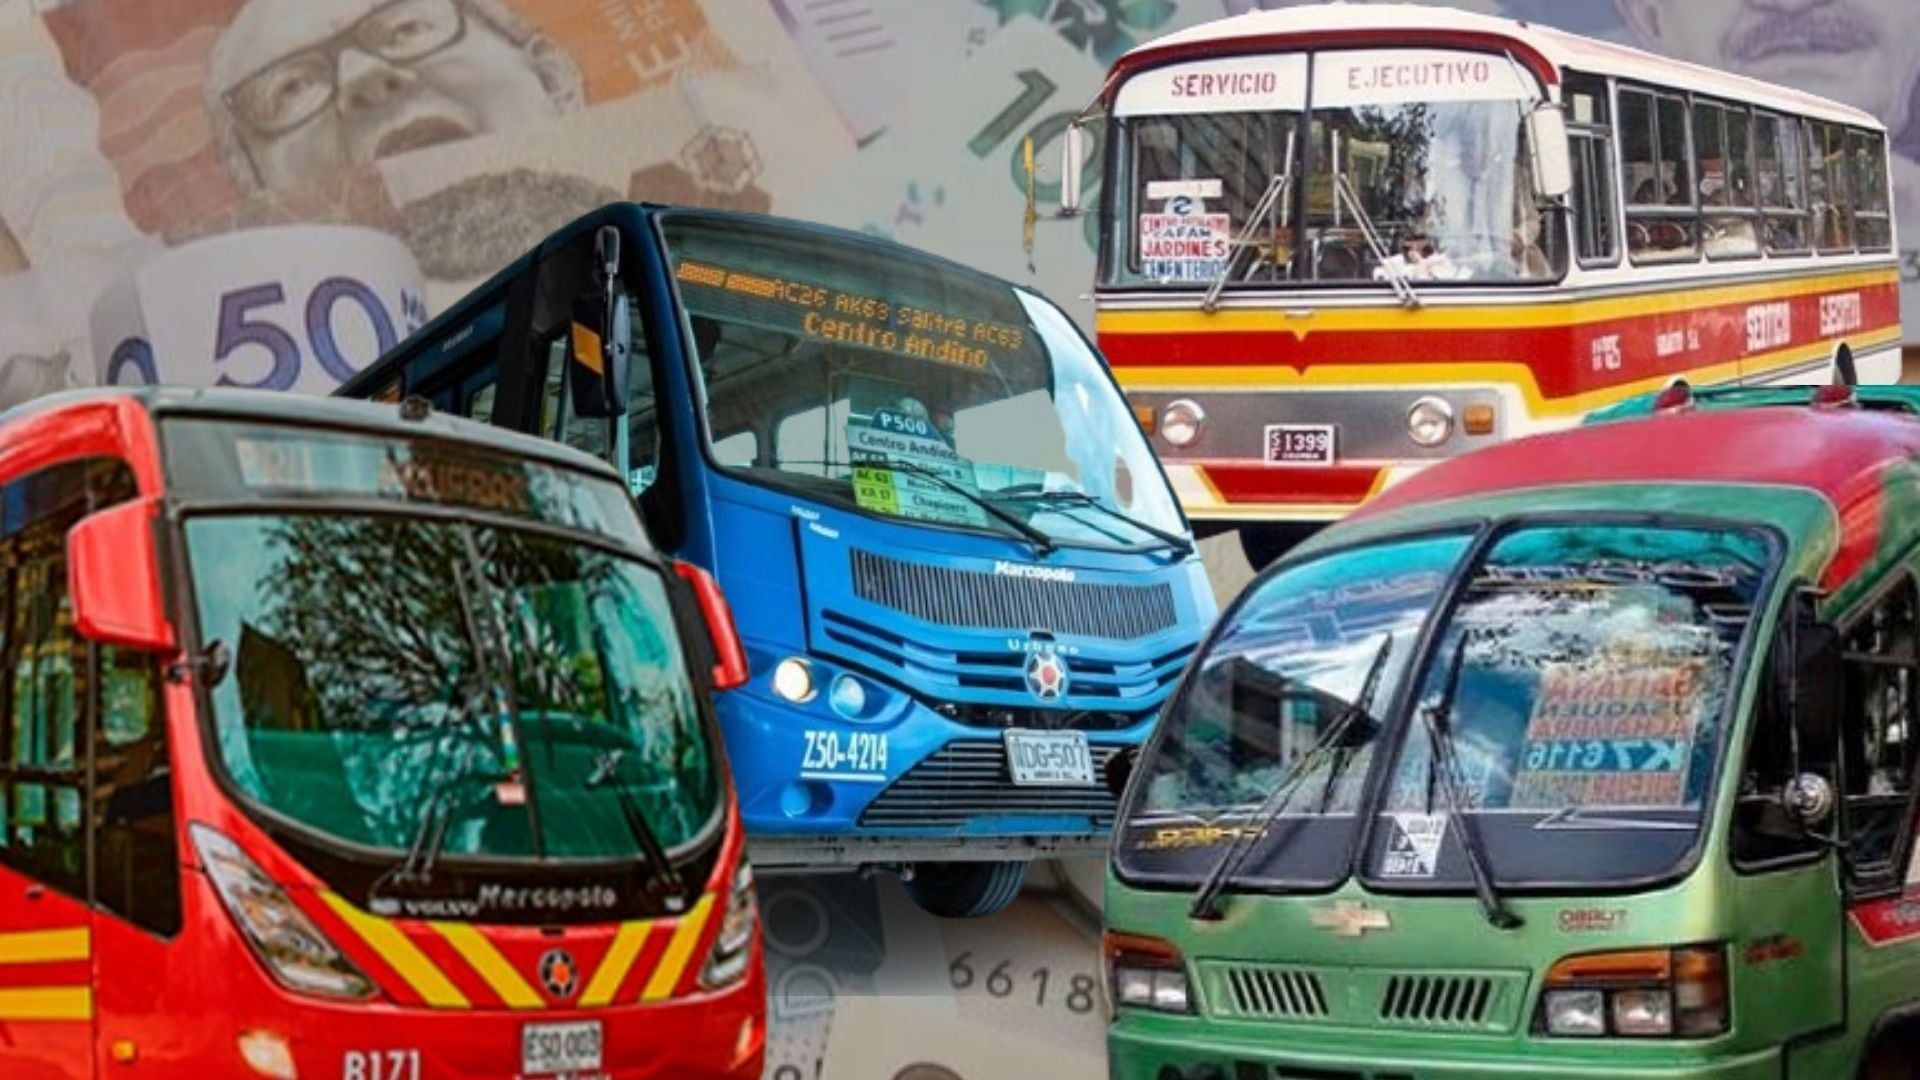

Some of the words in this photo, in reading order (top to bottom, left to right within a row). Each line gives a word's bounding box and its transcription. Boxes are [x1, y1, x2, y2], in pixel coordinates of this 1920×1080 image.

[1171, 73, 1277, 97] SERVICIO
[1348, 61, 1489, 90] EJECUTIVO
[1143, 241, 1225, 257] JARDINES
[803, 312, 897, 350] Centro
[903, 331, 989, 370] Andino
[879, 412, 928, 435] P500
[858, 431, 905, 452] Centro
[909, 441, 959, 462] Andino
[1285, 432, 1329, 452] 1399
[994, 561, 1076, 583] Marcopolo
[802, 730, 887, 770] Z50-4214
[478, 886, 616, 910] Marcopolo
